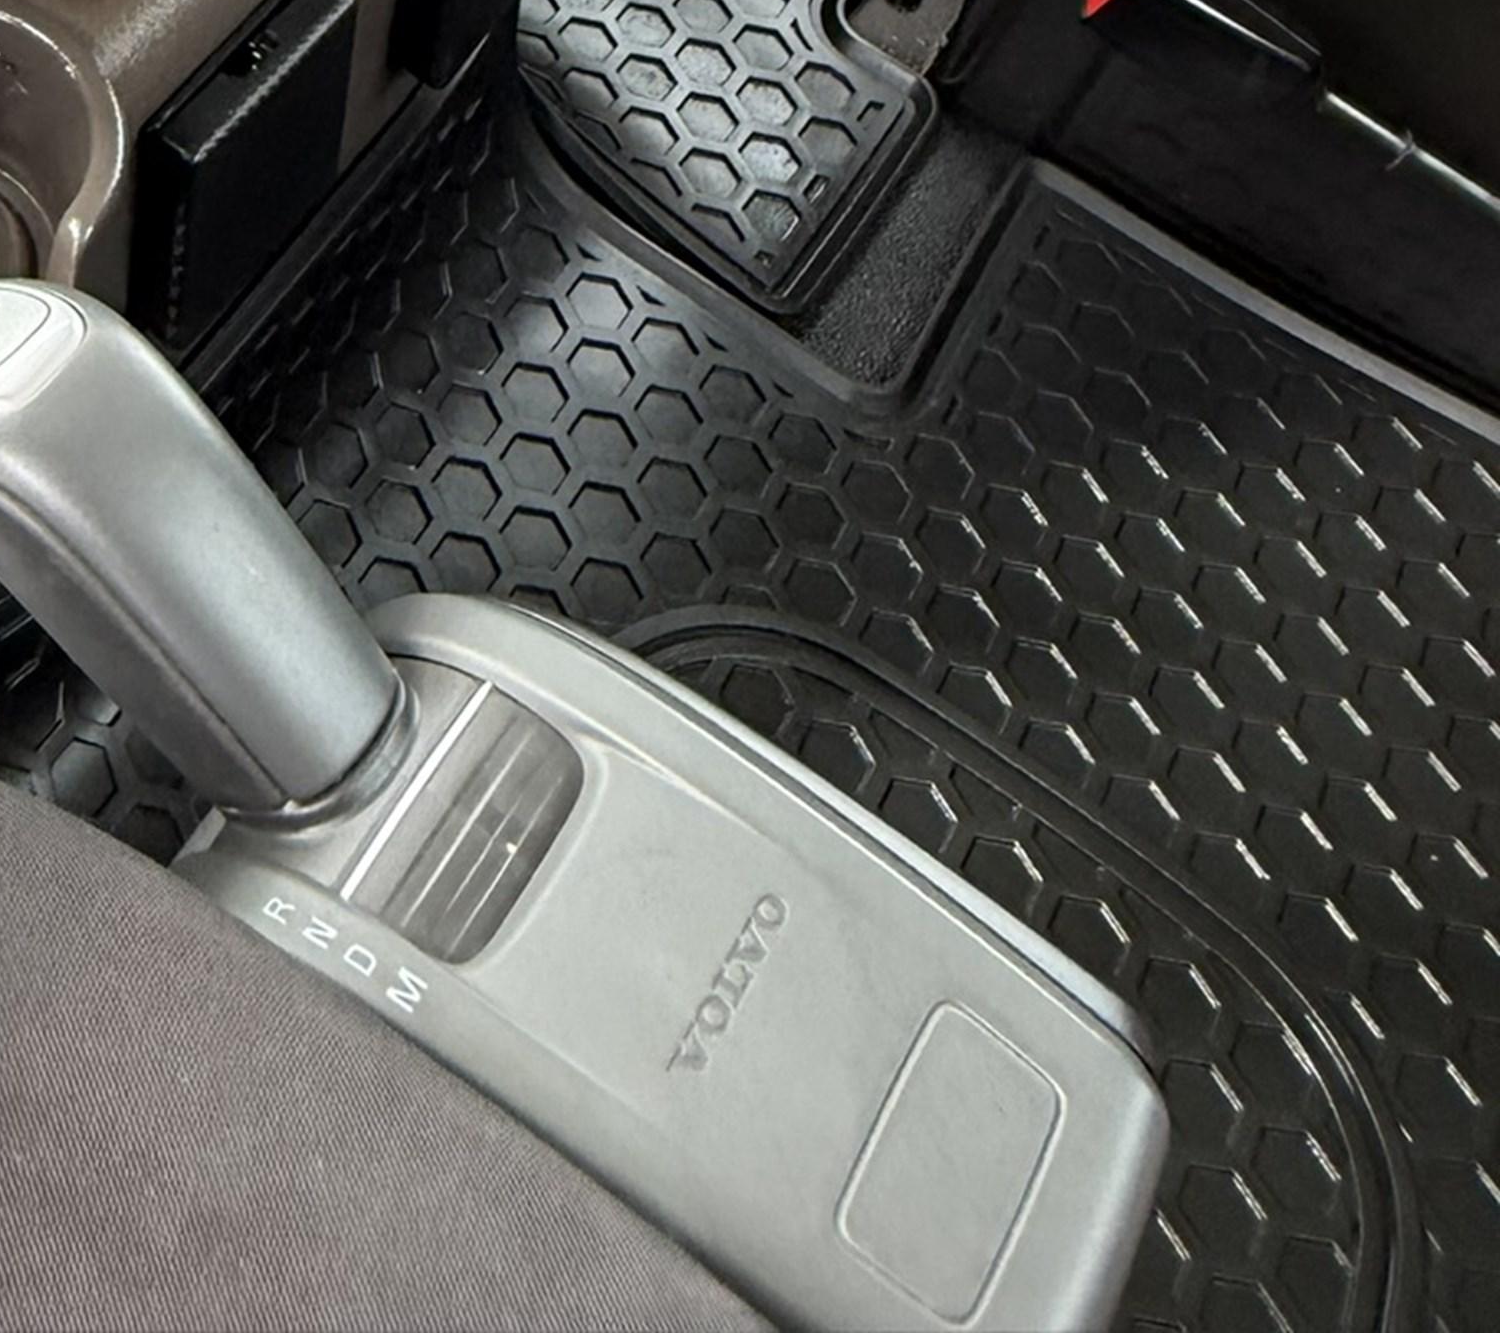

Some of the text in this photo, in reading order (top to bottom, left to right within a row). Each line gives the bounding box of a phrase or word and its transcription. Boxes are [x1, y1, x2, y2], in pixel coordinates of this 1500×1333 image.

[262, 895, 296, 925] R
[303, 919, 339, 949] N
[343, 948, 377, 976] D
[386, 967, 428, 1014] M
[664, 892, 789, 1074] VOLVO
